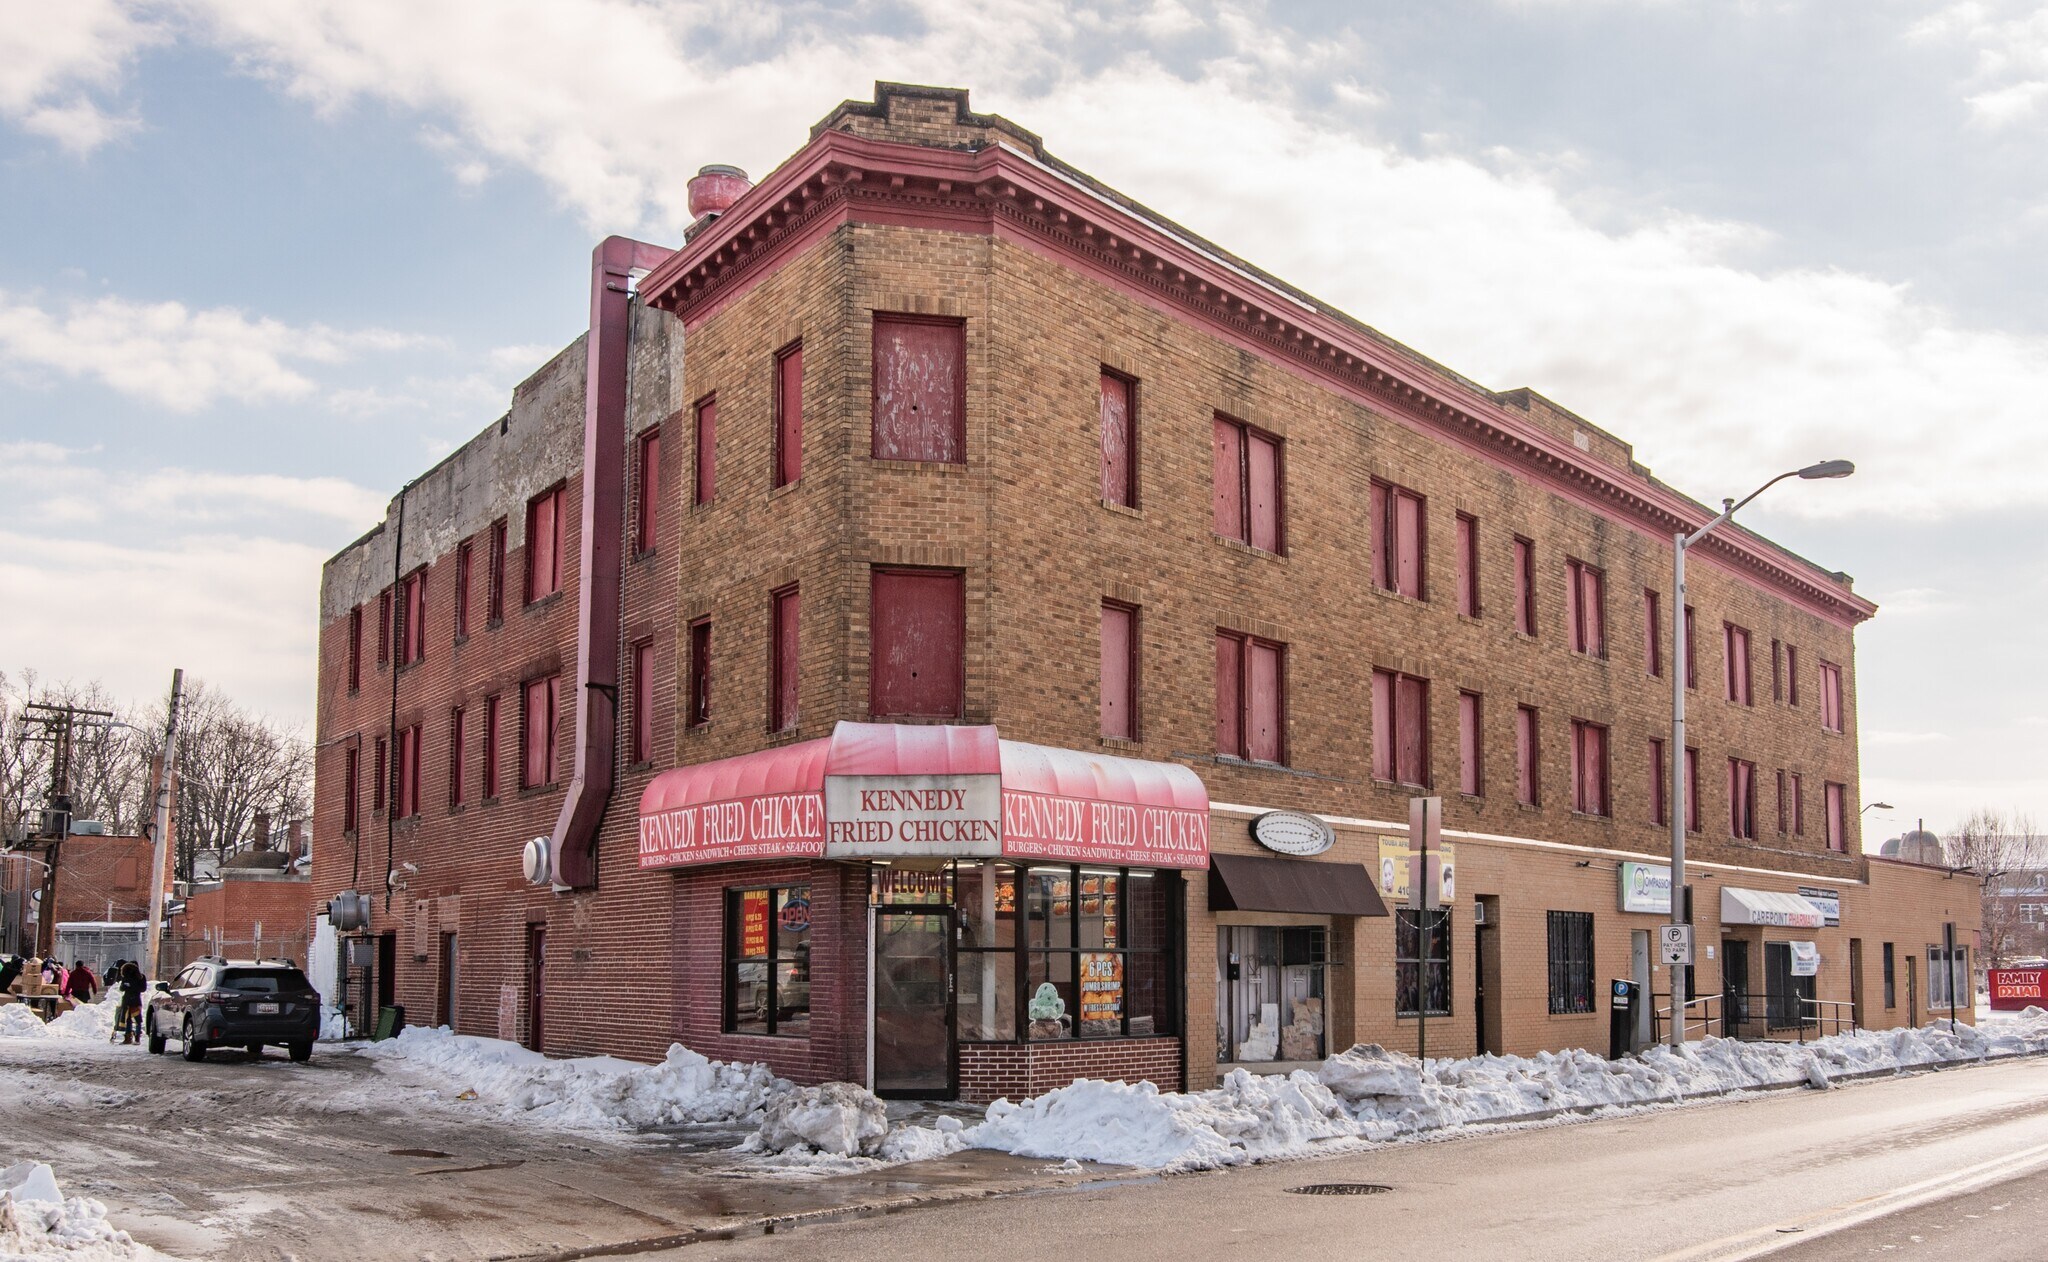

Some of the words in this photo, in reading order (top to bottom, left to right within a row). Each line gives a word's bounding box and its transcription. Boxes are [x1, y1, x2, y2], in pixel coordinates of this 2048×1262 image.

[860, 789, 967, 812] KENNEDY
[639, 808, 698, 854] KENNEDY
[702, 801, 746, 846] FRIED
[751, 794, 825, 840] CHICKEN
[829, 820, 893, 843] FRIED
[899, 819, 999, 842] CHICKEN
[1003, 792, 1086, 844] KENNEDY
[1091, 802, 1138, 847] FRIED
[1142, 808, 1209, 852] CHICKEN
[641, 854, 666, 867] BURGERS
[669, 851, 696, 864] CHICKEN
[695, 846, 730, 860] SANDWICH
[733, 844, 758, 856] CHEESE
[758, 842, 781, 855] STEAK
[1007, 840, 1043, 854] BURGERS
[1047, 843, 1082, 857] CHICKEN
[1082, 846, 1121, 860] SANDWICH
[1126, 850, 1151, 862] CHEESE
[1151, 851, 1173, 863] STEAK
[1176, 853, 1206, 866] SEAFOOD
[878, 868, 947, 894] WELCOME
[1752, 911, 1788, 926] CAREPOINT
[1788, 912, 1819, 928] PHARMACY
[1089, 961, 1095, 977] 6
[1096, 961, 1115, 977] PCS.
[1997, 972, 2042, 985] FAMILY
[1998, 985, 2042, 998] DOLLAR
